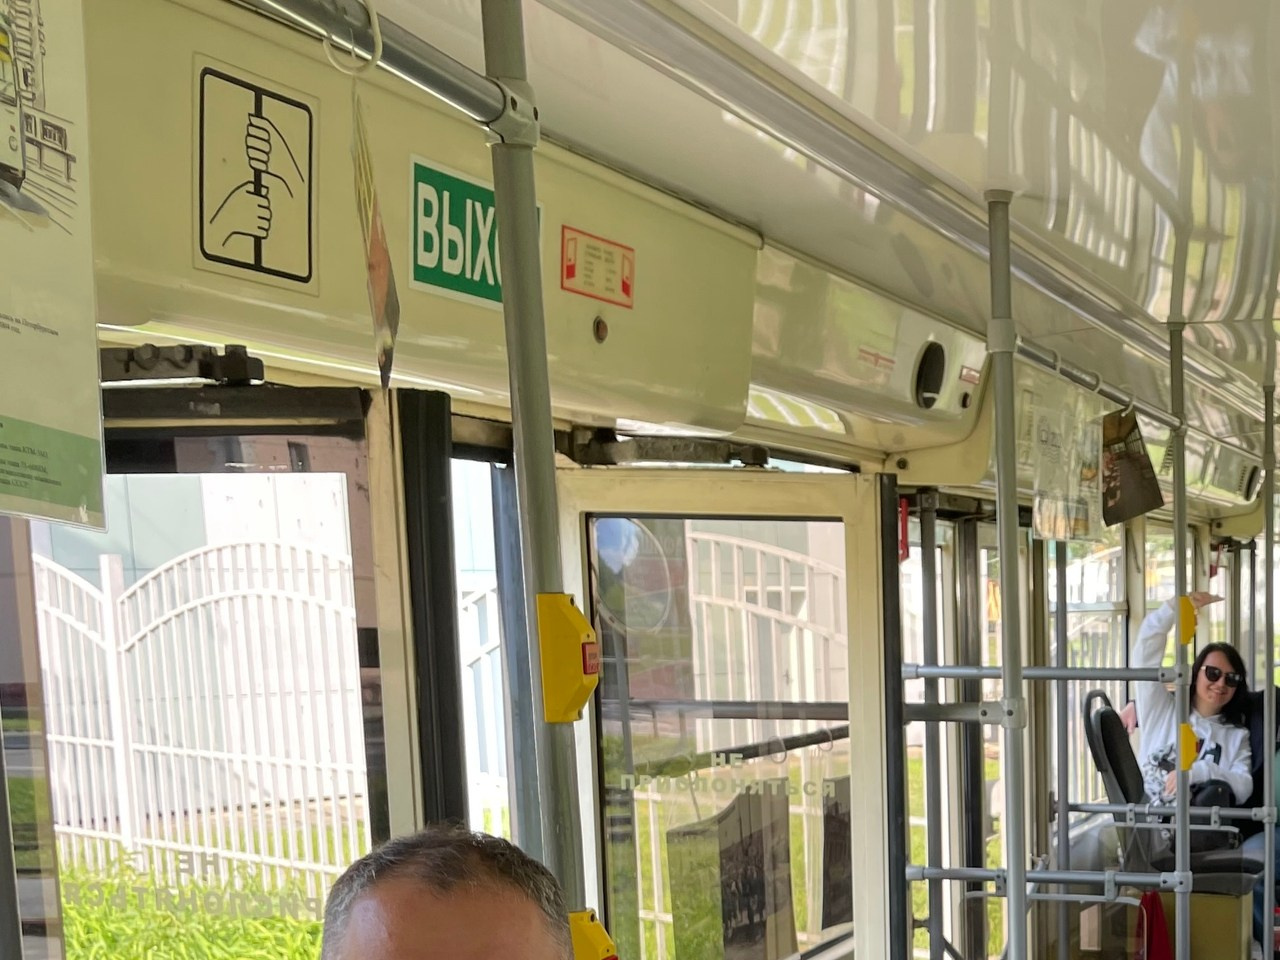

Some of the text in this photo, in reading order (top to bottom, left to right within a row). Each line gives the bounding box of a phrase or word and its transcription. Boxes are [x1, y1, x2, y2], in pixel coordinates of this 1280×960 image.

[417, 181, 501, 287] ВЫХ
[711, 752, 744, 768] НЕ
[620, 773, 836, 798] ПРИСЛОНЯТЬСЯ
